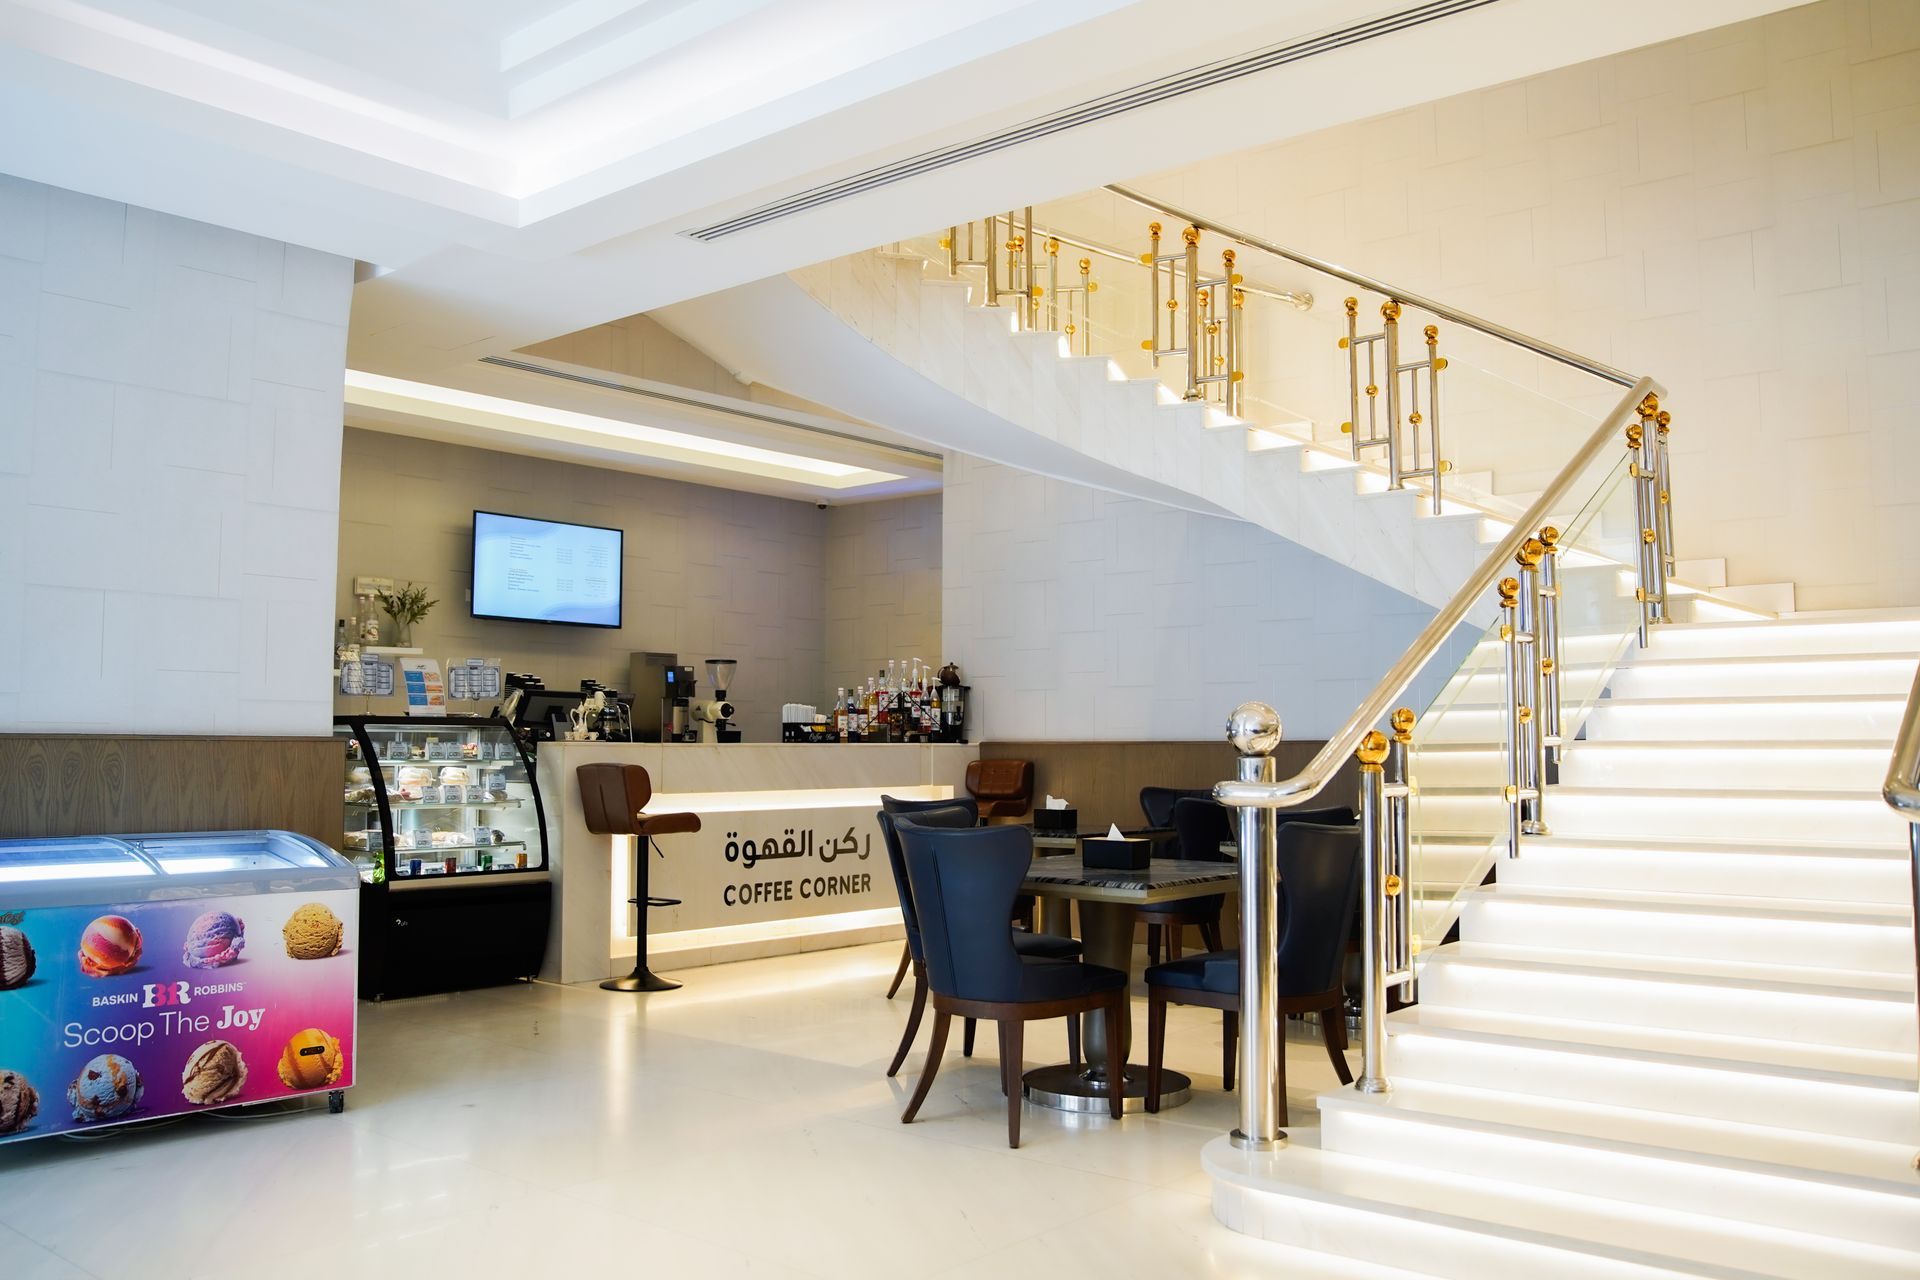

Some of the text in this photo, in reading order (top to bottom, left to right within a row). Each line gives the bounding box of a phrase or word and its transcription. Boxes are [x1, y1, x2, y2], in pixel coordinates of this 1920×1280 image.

[724, 826, 871, 870] ركن القهوة
[723, 873, 871, 907] COFFEE CORNER
[92, 993, 139, 1007] BASKIN
[193, 982, 245, 997] ROBBINS
[63, 1005, 266, 1048] Scoop The Joy
